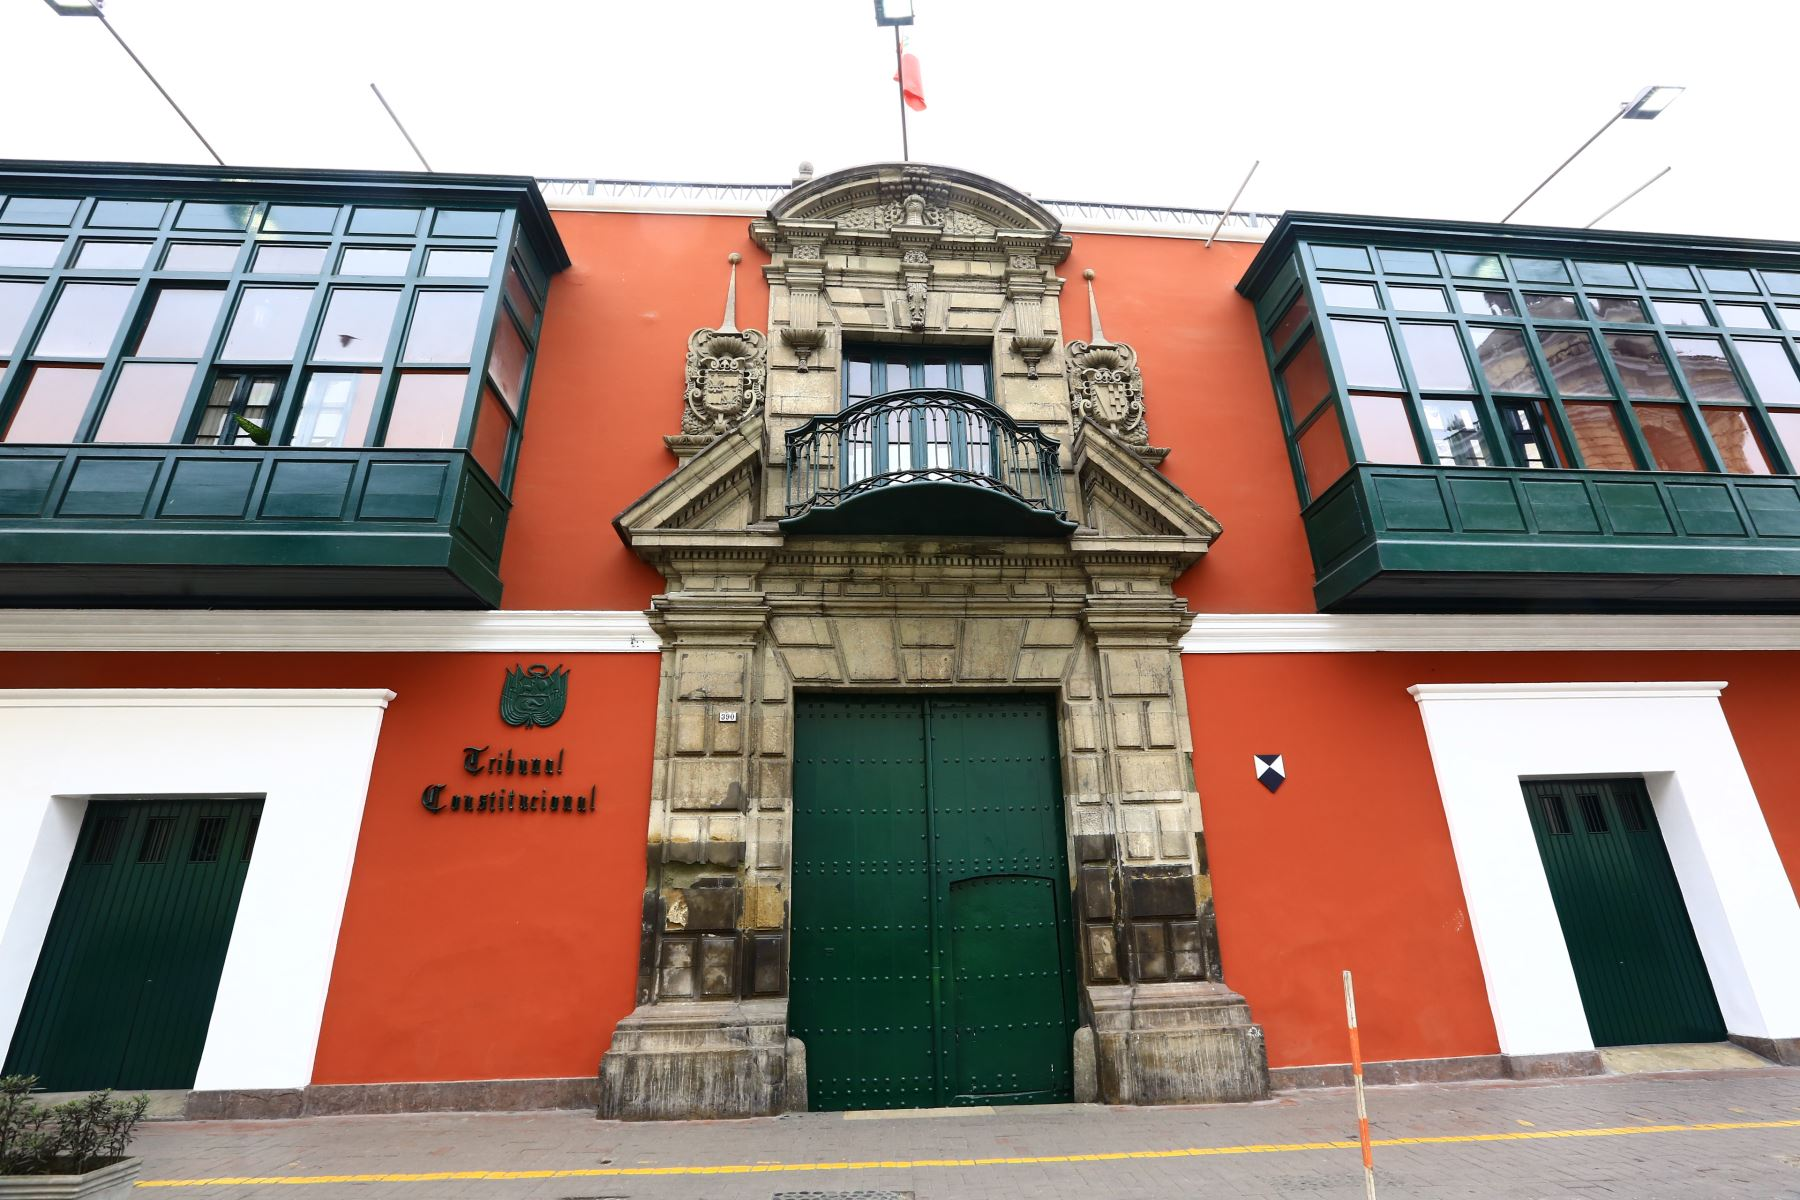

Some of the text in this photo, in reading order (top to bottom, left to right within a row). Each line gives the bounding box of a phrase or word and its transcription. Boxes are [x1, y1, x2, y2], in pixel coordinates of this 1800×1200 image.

[720, 713, 735, 721] 390
[463, 745, 565, 776] Tribunal
[421, 783, 596, 814] Constitucional
